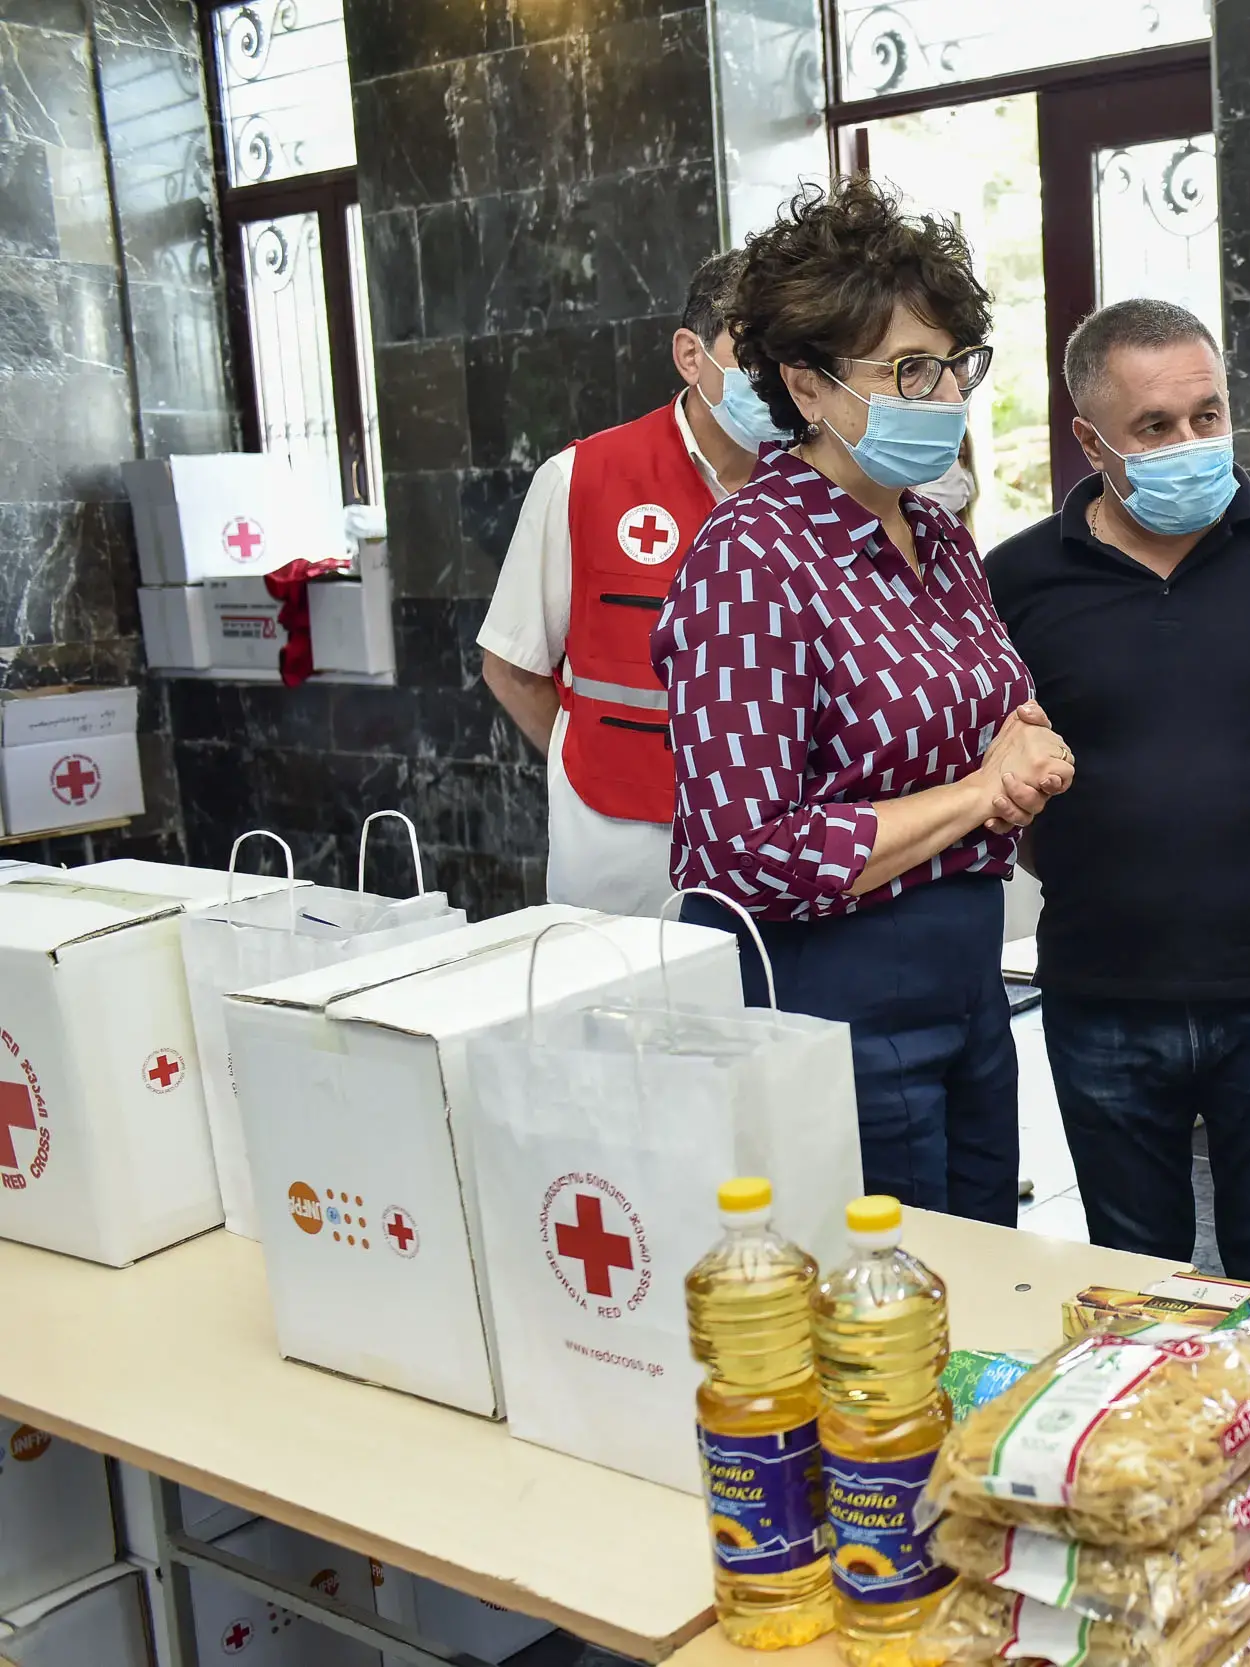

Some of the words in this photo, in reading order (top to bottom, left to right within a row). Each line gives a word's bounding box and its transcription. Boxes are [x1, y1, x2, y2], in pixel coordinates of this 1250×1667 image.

[1, 1173, 26, 1190] RED
[30, 1127, 51, 1179] CROSS
[545, 1250, 588, 1310] GEORGIA
[597, 1306, 621, 1319] RED
[626, 1268, 652, 1311] CROSS
[564, 1338, 665, 1377] www.redcross.ge
